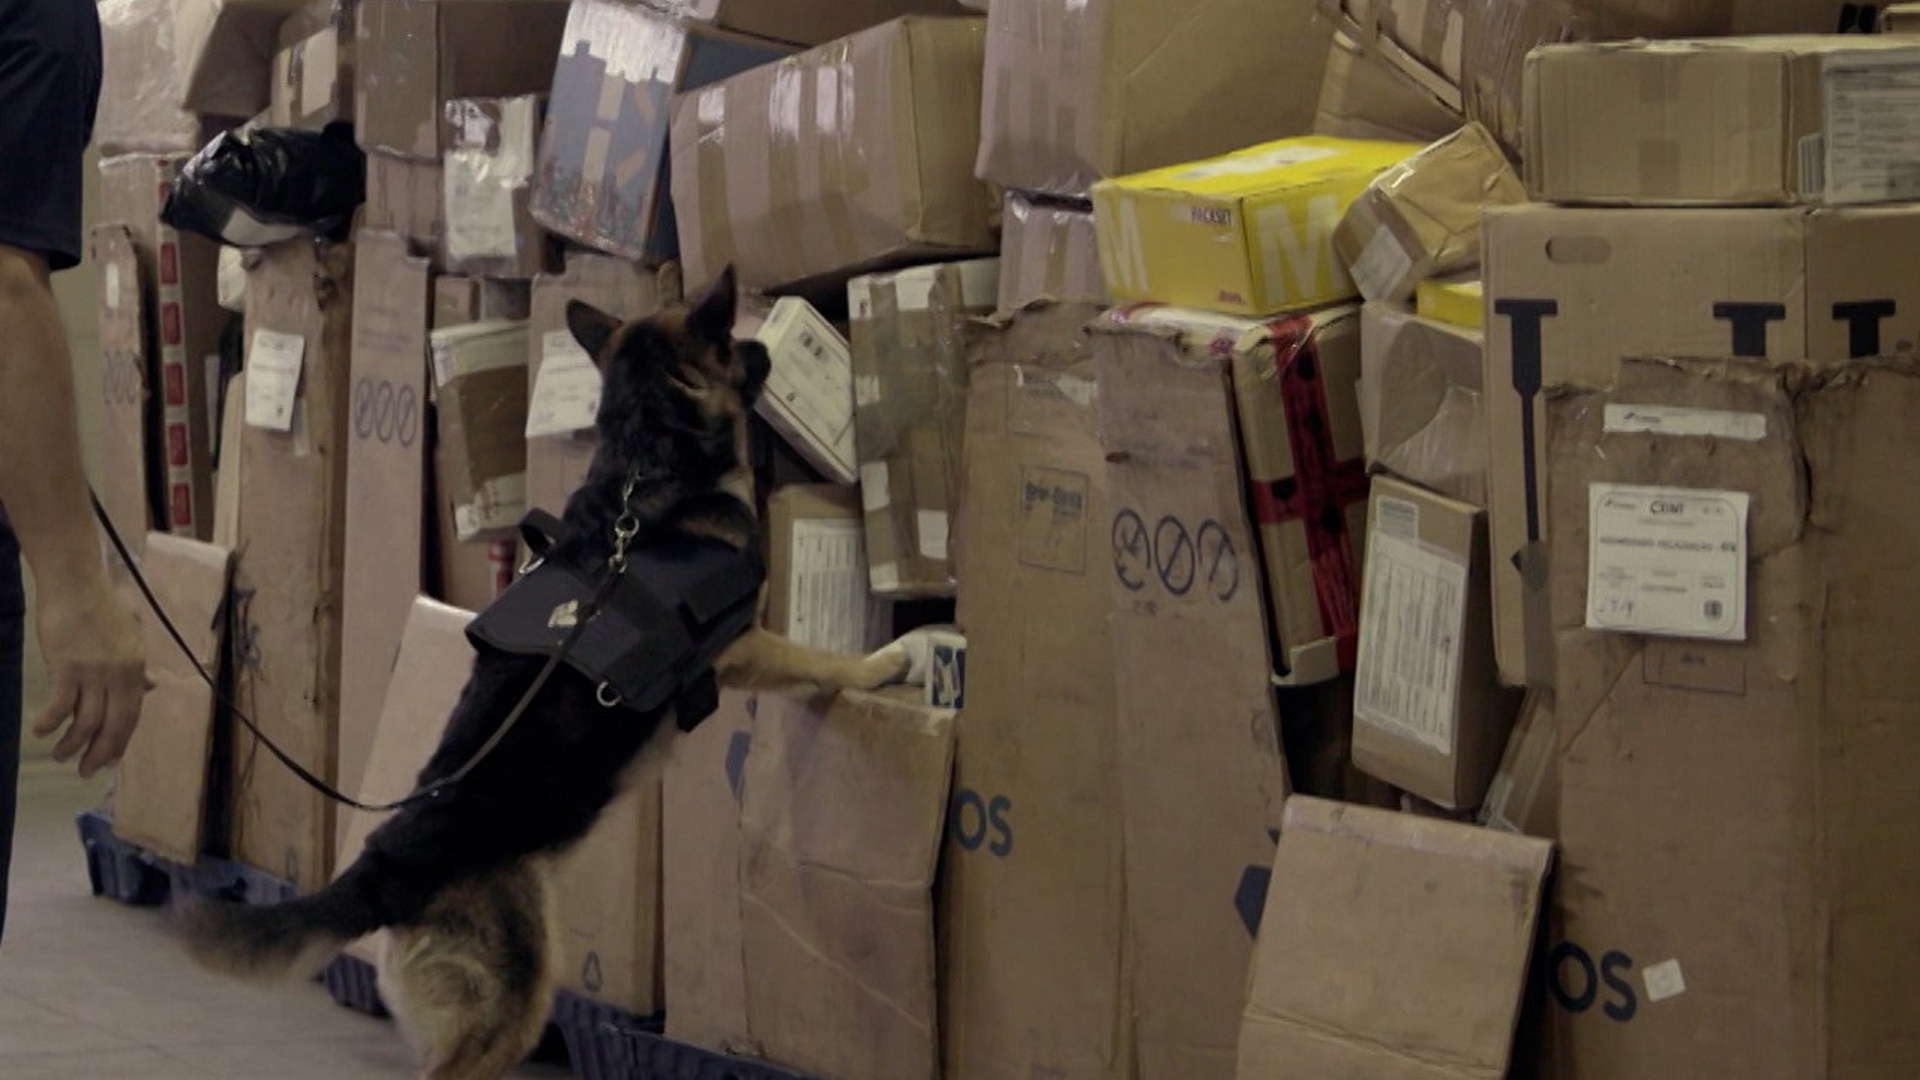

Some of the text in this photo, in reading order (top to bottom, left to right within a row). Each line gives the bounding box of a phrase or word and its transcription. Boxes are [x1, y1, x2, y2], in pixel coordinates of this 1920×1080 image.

[1254, 195, 1349, 304] M
[951, 789, 1013, 857] OS
[1550, 940, 1637, 1022] OS
